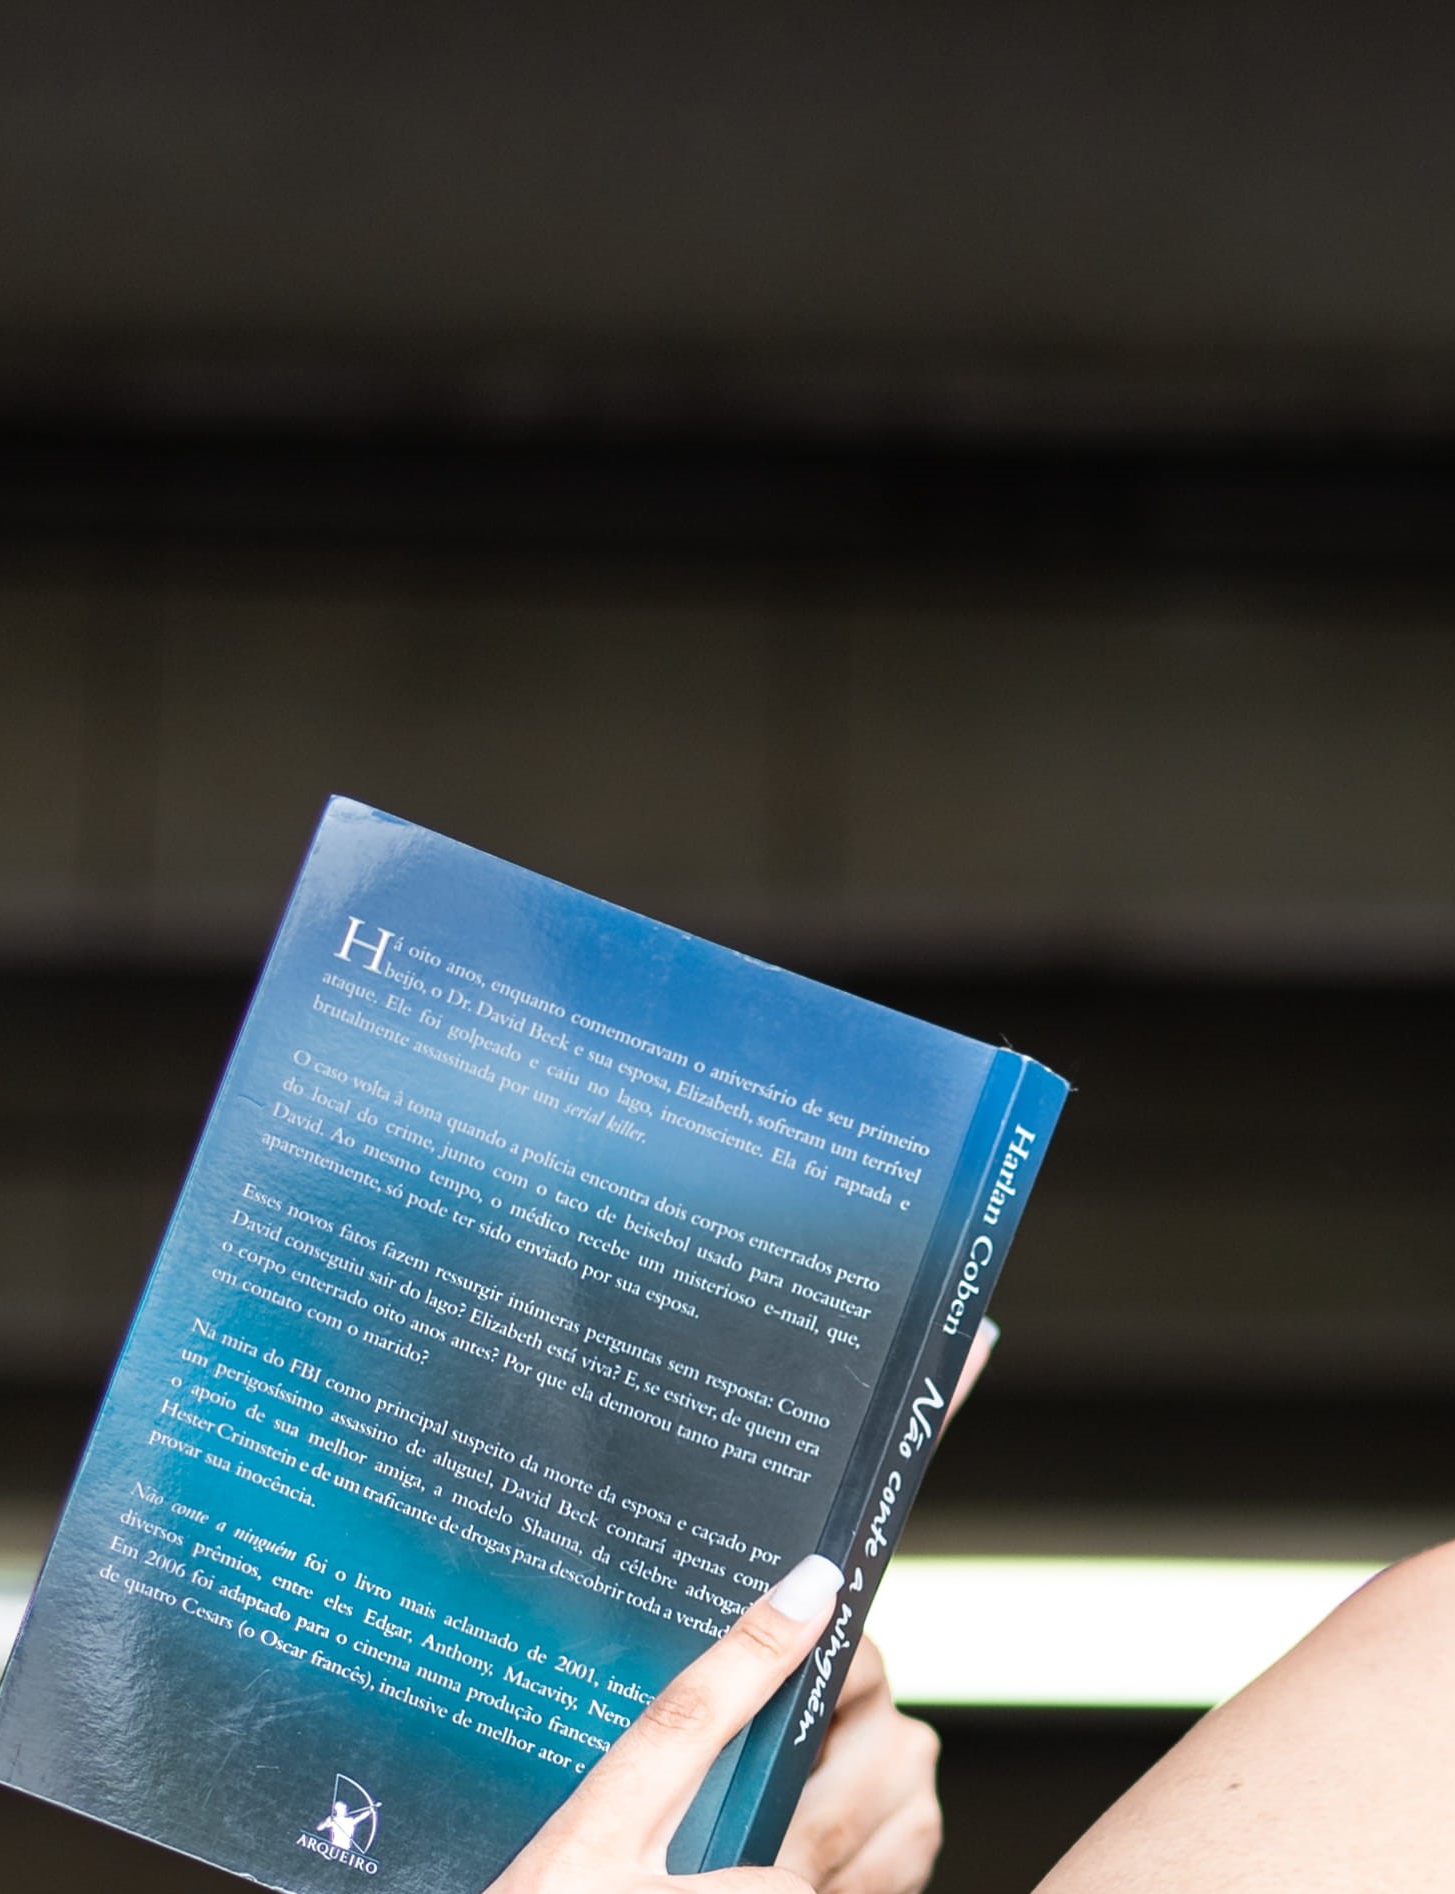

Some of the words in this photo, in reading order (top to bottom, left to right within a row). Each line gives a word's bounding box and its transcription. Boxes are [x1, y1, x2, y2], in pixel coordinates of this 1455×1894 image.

[312, 993, 410, 1047] brutalmente
[412, 1041, 496, 1083] assassinada
[562, 1103, 607, 1126] serial
[605, 1114, 647, 1145] killer.
[321, 973, 378, 1004] ataque.
[446, 1025, 522, 1062] golpeado
[545, 1065, 580, 1086] caiu
[616, 1087, 653, 1118] lago,
[659, 1105, 764, 1158] inconsciente.
[833, 1175, 892, 1205] raptada
[383, 961, 427, 995] beijo,
[475, 1000, 527, 1033] David
[528, 1022, 570, 1052] Beck
[617, 1063, 672, 1094] esposa,
[674, 1080, 754, 1125] Elizabeth,
[756, 1115, 826, 1150] sofreram
[861, 1153, 923, 1185] terrível
[408, 945, 442, 968] oito
[445, 962, 486, 989] anos,
[490, 981, 566, 1018] enquanto
[570, 1013, 689, 1067] comemoravam
[709, 1067, 798, 1108] aniversário
[826, 1110, 855, 1129] seu
[856, 1122, 931, 1157] primeiro
[261, 1132, 382, 1194] aparentemente,
[404, 1192, 449, 1218] pode
[478, 1220, 512, 1244] sido
[515, 1238, 579, 1271] enviado
[645, 1289, 700, 1320] esposa.
[272, 1101, 325, 1137] David.
[362, 1143, 422, 1175] mesmo
[428, 1169, 483, 1204] tempo,
[509, 1204, 570, 1236] médico
[577, 1231, 631, 1260] recebe
[672, 1268, 757, 1308] misterioso
[763, 1304, 820, 1335] e-mail,
[310, 1086, 352, 1115] local
[384, 1122, 436, 1153] crime,
[436, 1141, 486, 1171] junto
[554, 1190, 589, 1213] taco
[623, 1213, 692, 1253] beisebol
[696, 1246, 743, 1272] usado
[747, 1266, 784, 1289] para
[790, 1282, 872, 1320] nocautear
[313, 1062, 349, 1084] caso
[352, 1076, 391, 1102] volta
[407, 1099, 443, 1124] tona
[446, 1117, 507, 1149] quando
[520, 1147, 576, 1178] polícia
[579, 1171, 650, 1207] encontra
[653, 1196, 687, 1221] dois
[690, 1214, 746, 1243] corpos
[748, 1236, 833, 1275] enterrados
[833, 1267, 881, 1293] perto
[982, 1123, 1036, 1226] Harlan
[230, 1208, 283, 1243] David
[283, 1236, 365, 1277] conseguiu
[368, 1270, 398, 1289] sair
[424, 1288, 467, 1318] lago?
[468, 1307, 543, 1350] Elizabeth
[546, 1344, 578, 1364] está
[581, 1356, 622, 1380] viva?
[663, 1390, 718, 1421] estiver,
[744, 1420, 792, 1446] quem
[237, 1247, 287, 1275] corpo
[290, 1270, 369, 1309] enterrado
[372, 1303, 406, 1325] oito
[409, 1319, 446, 1342] anos
[450, 1336, 500, 1363] antes?
[598, 1391, 673, 1433] demorou
[676, 1424, 719, 1450] tanto
[720, 1442, 758, 1465] para
[761, 1458, 812, 1484] entrar
[240, 1281, 303, 1313] contato
[362, 1330, 430, 1366] marido?
[241, 1182, 283, 1212] Esses
[286, 1205, 334, 1233] novos
[338, 1223, 377, 1251] fatos
[381, 1240, 430, 1273] fazem
[434, 1266, 504, 1302] ressurgir
[507, 1292, 580, 1334] inúmeras
[583, 1327, 663, 1366] perguntas
[704, 1373, 774, 1409] resposta:
[777, 1397, 831, 1429] Como
[942, 1235, 994, 1336] Coben
[147, 1429, 204, 1459] provar
[235, 1460, 316, 1508] inocência.
[160, 1398, 217, 1433] Hester
[216, 1422, 297, 1468] Crimstein
[362, 1485, 438, 1526] traficante
[460, 1524, 512, 1556] drogas
[510, 1548, 547, 1571] para
[548, 1559, 626, 1601] descobrir
[625, 1592, 662, 1616] toda
[190, 1385, 237, 1410] apoio
[308, 1432, 368, 1465] melhor
[373, 1461, 426, 1493] amiga,
[451, 1492, 513, 1525] modelo
[521, 1516, 583, 1556] Shauna,
[619, 1558, 678, 1590] célebre
[213, 1363, 324, 1416] perigosíssimo
[330, 1411, 399, 1447] assassino
[432, 1451, 494, 1489] aluguel,
[500, 1476, 552, 1509] David
[557, 1499, 599, 1529] Beck
[606, 1523, 667, 1555] contará
[672, 1549, 727, 1577] apenas
[220, 1334, 259, 1358] mira
[324, 1378, 372, 1404] como
[373, 1397, 449, 1436] principal
[452, 1429, 516, 1463] suspeito
[543, 1466, 594, 1495] morte
[621, 1498, 672, 1526] esposa
[691, 1525, 747, 1553] caçado
[864, 1470, 902, 1558] conte
[898, 1377, 945, 1459] Não
[119, 1508, 184, 1546] diversos
[191, 1542, 262, 1582] prêmios,
[271, 1575, 314, 1600] entre
[323, 1594, 354, 1617] eles
[362, 1608, 413, 1644] Edgar,
[420, 1633, 494, 1677] Anthony,
[502, 1665, 578, 1711] Macavity,
[587, 1699, 631, 1728] Nero
[123, 1578, 177, 1606] quatro
[181, 1597, 234, 1630] Cesars
[259, 1629, 308, 1660] Oscar
[310, 1649, 375, 1692] francês),
[378, 1677, 449, 1719] inclusive
[475, 1722, 536, 1754] melhor
[537, 1747, 573, 1768] ator
[143, 1549, 186, 1578] 2006
[218, 1584, 291, 1621] adaptado
[293, 1615, 330, 1639] para
[352, 1639, 411, 1672] cinema
[415, 1666, 462, 1693] numa
[464, 1686, 543, 1725] produção
[170, 1503, 210, 1524] conte
[233, 1527, 298, 1561] ninguém
[353, 1572, 392, 1601] livro
[399, 1596, 437, 1619] mais
[443, 1615, 519, 1653] aclamado
[553, 1655, 599, 1688] 2001,
[794, 1603, 853, 1746] ninguém
[849, 1567, 864, 1593] a
[296, 1833, 378, 1875] ARQUEIRO
